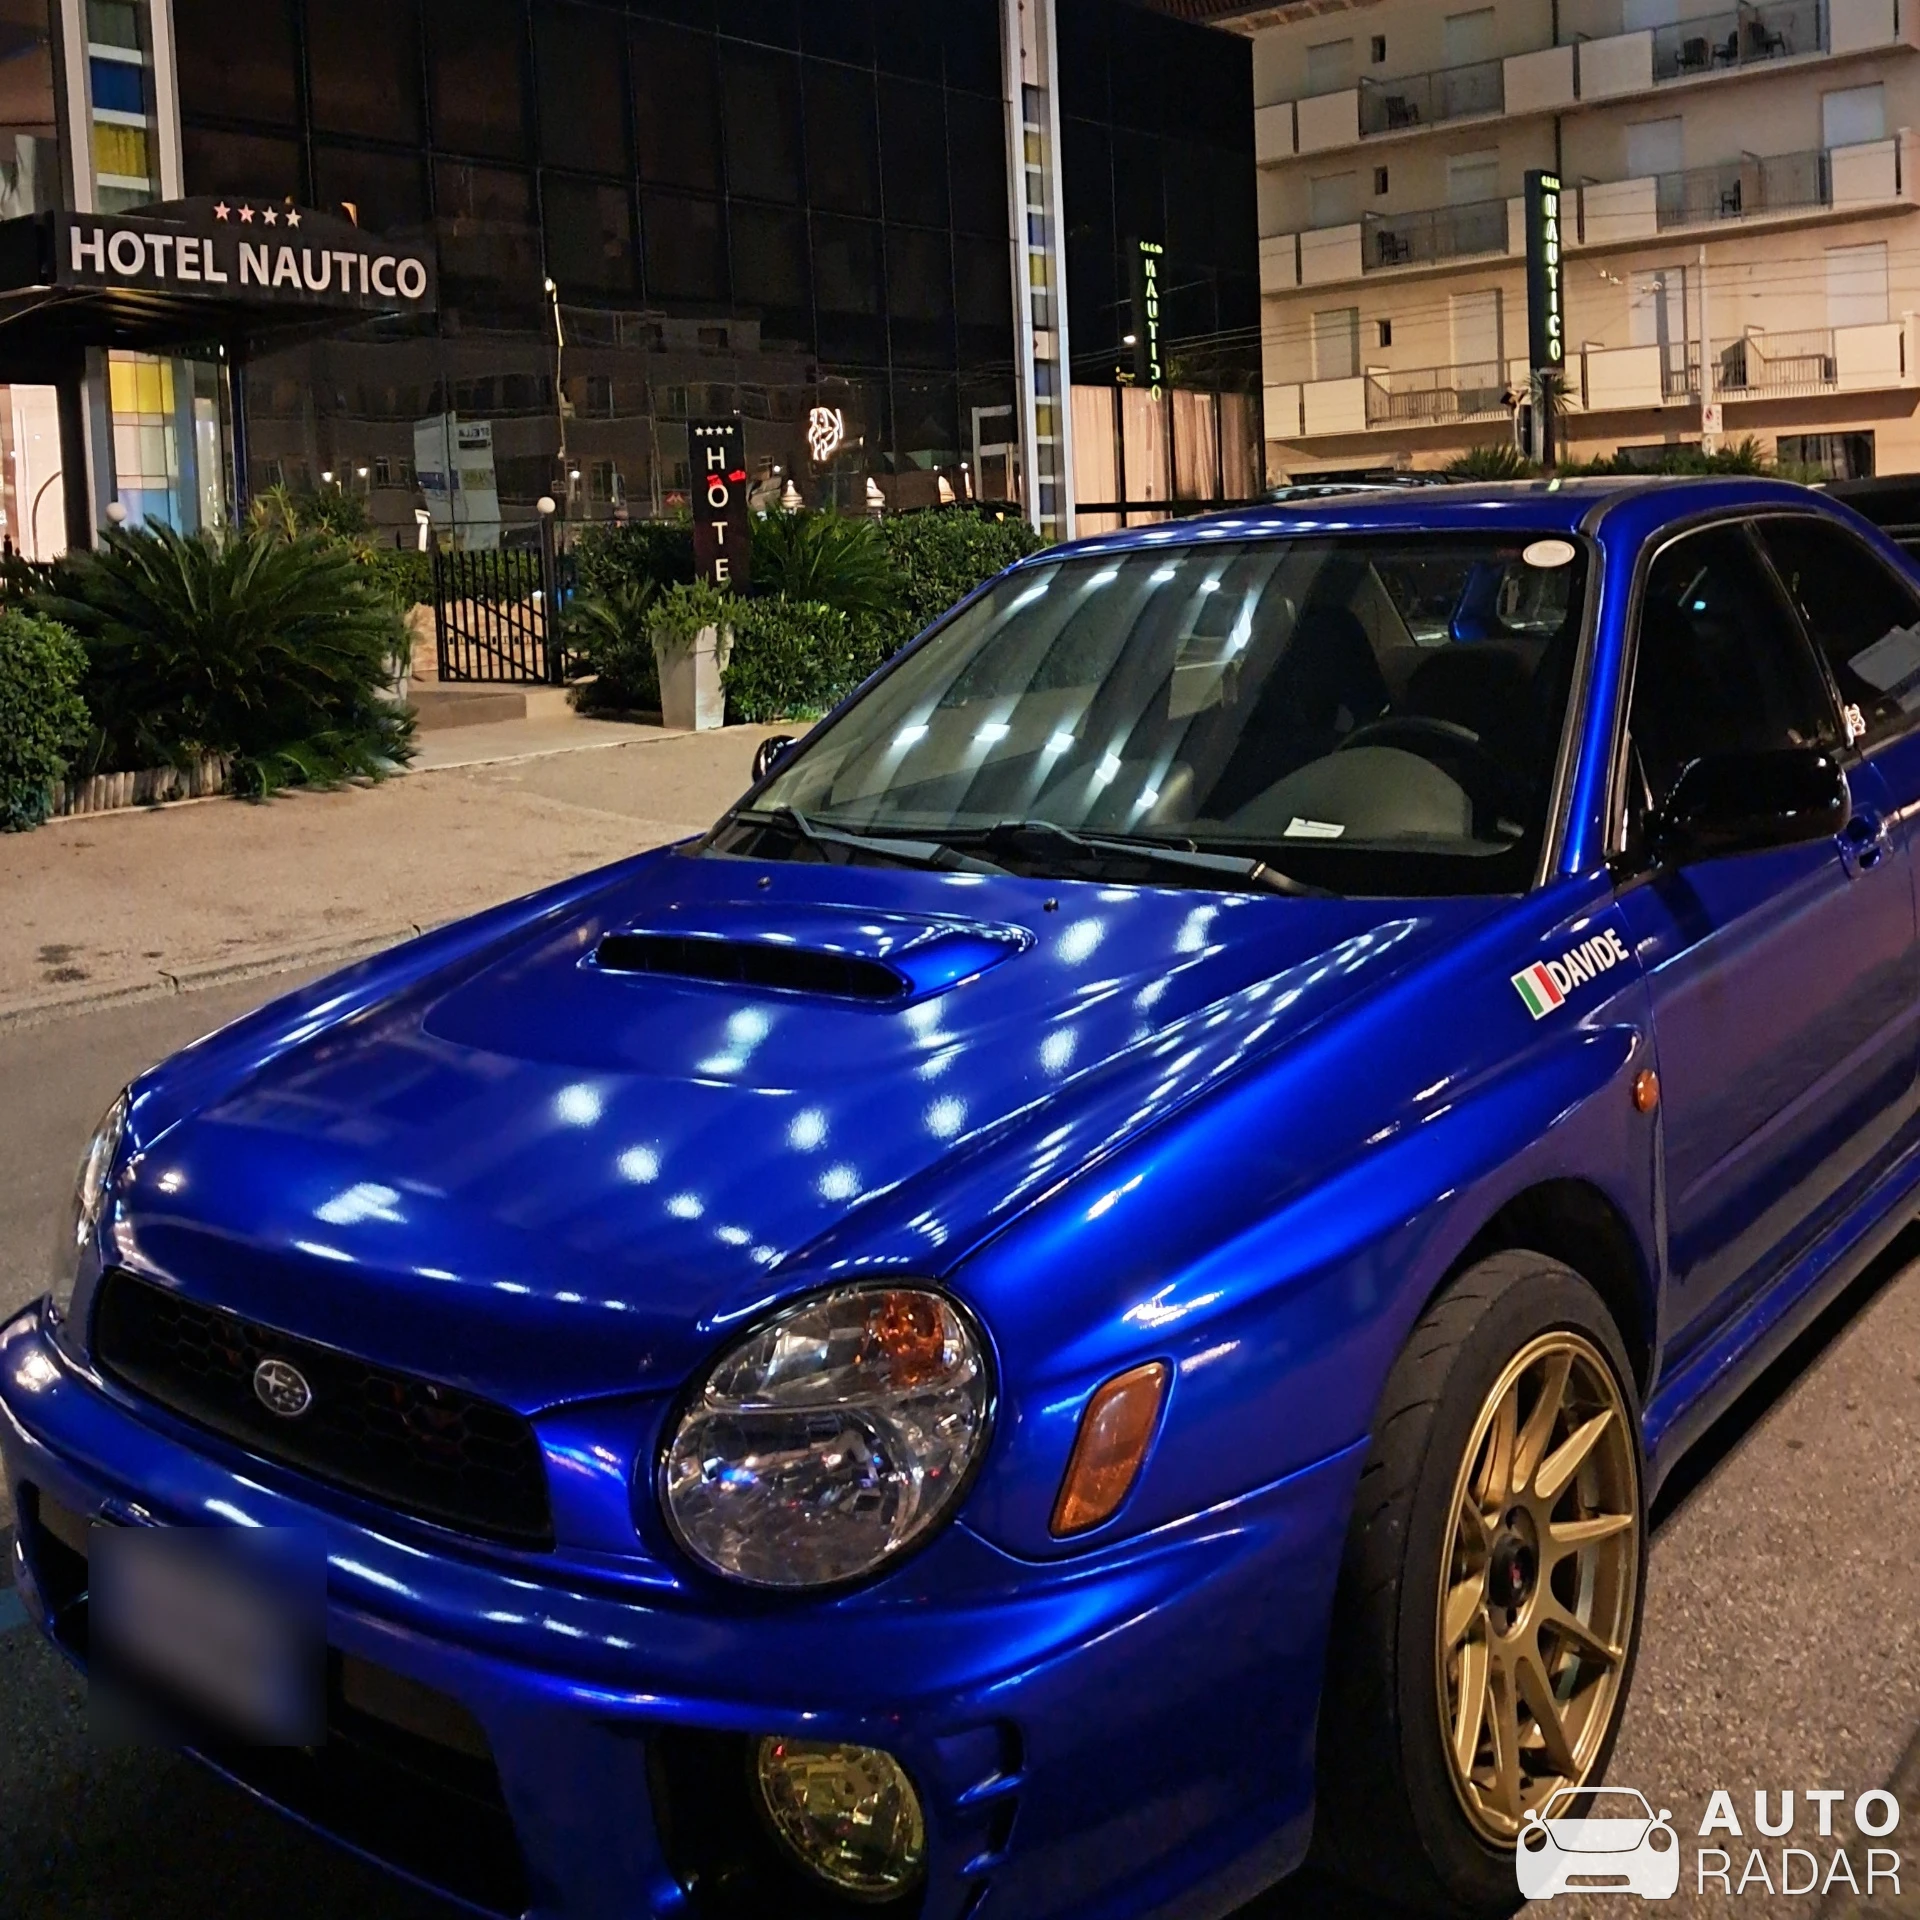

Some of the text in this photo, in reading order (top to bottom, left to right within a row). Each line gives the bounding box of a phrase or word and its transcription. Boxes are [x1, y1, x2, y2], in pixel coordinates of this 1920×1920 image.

[70, 226, 427, 298] HOTEL NAUTICO
[1544, 194, 1561, 361] NAUTICO
[706, 446, 729, 606] HOTE
[1545, 927, 1630, 995] DAVIDE
